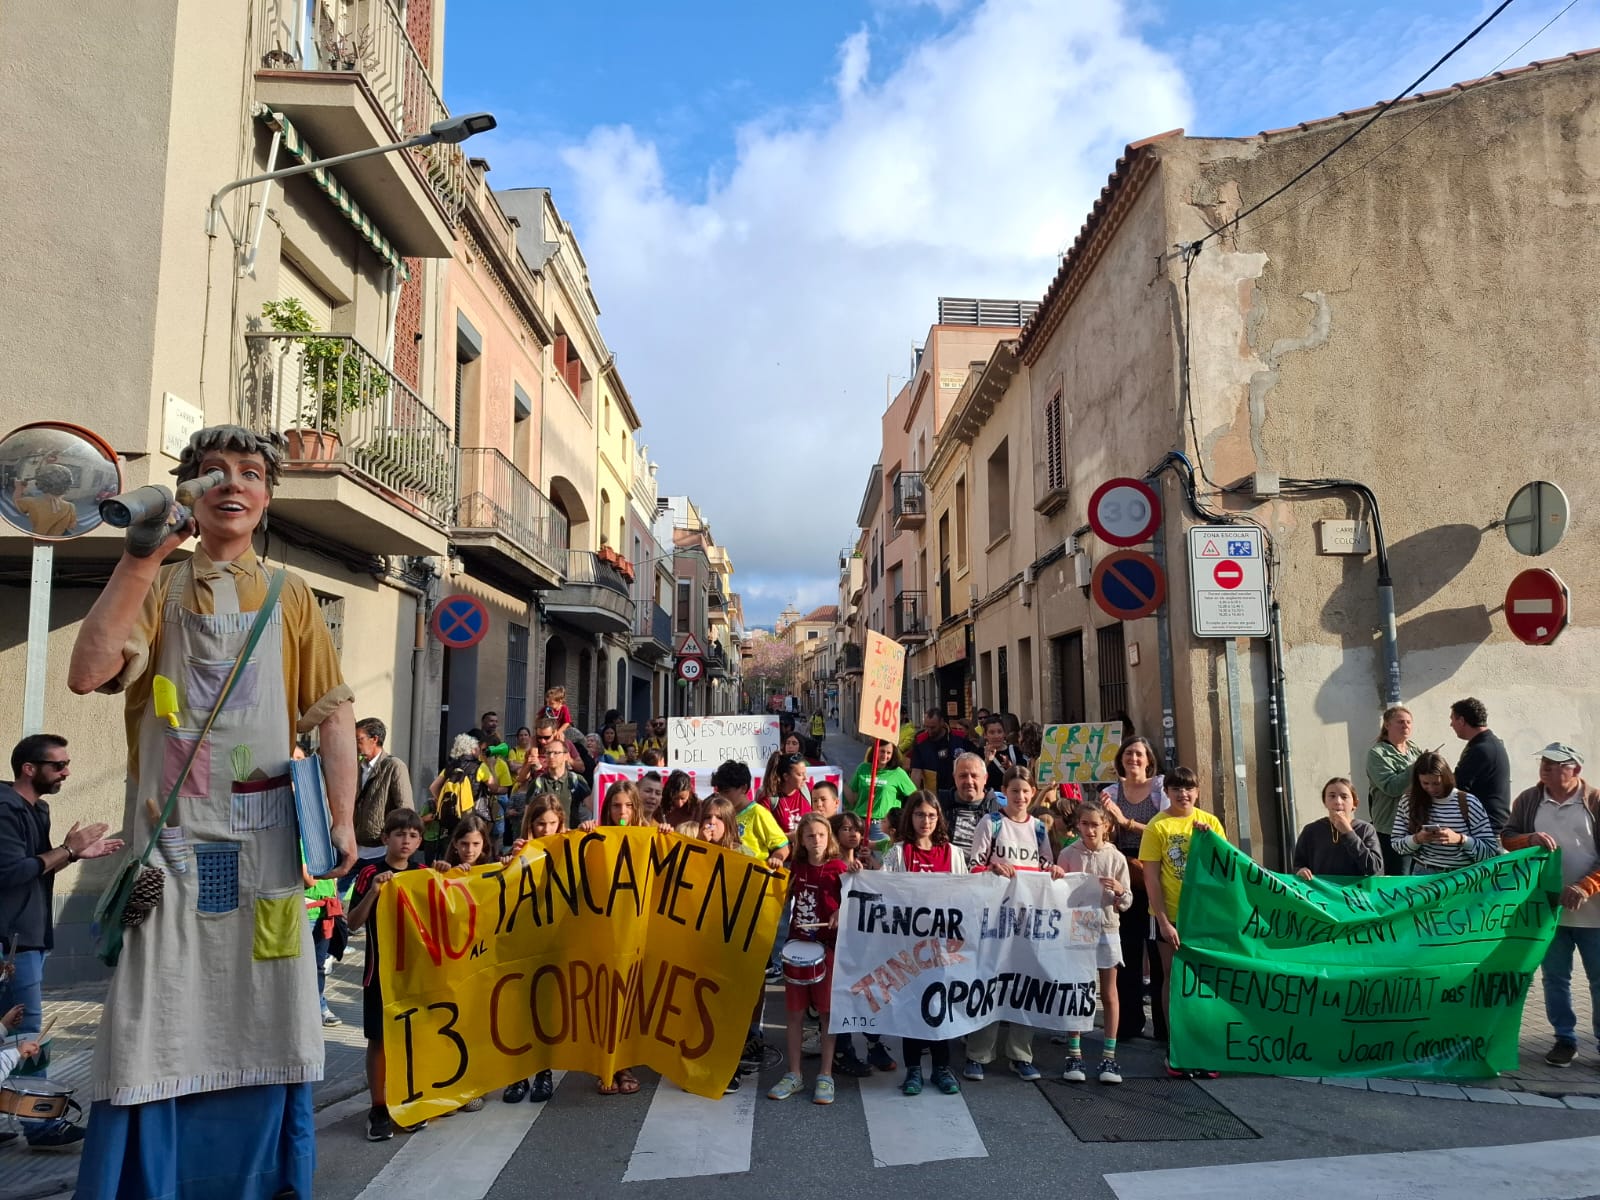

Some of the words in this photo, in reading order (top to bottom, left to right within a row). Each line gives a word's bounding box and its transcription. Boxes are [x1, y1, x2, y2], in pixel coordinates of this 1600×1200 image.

[1103, 500, 1146, 523] 30
[684, 665, 698, 674] 30
[874, 695, 900, 734] SOS
[684, 748, 708, 764] DEL
[395, 878, 478, 971] NO
[469, 944, 488, 961] AL
[482, 832, 786, 953] TANCAMENT
[847, 890, 964, 941] TANCAR
[851, 938, 969, 1013] TANCAR
[1181, 960, 1319, 1016] DEFENSEM
[1322, 989, 1340, 1008] LA
[1225, 1021, 1313, 1065] Escola
[1338, 1029, 1395, 1063] Joan
